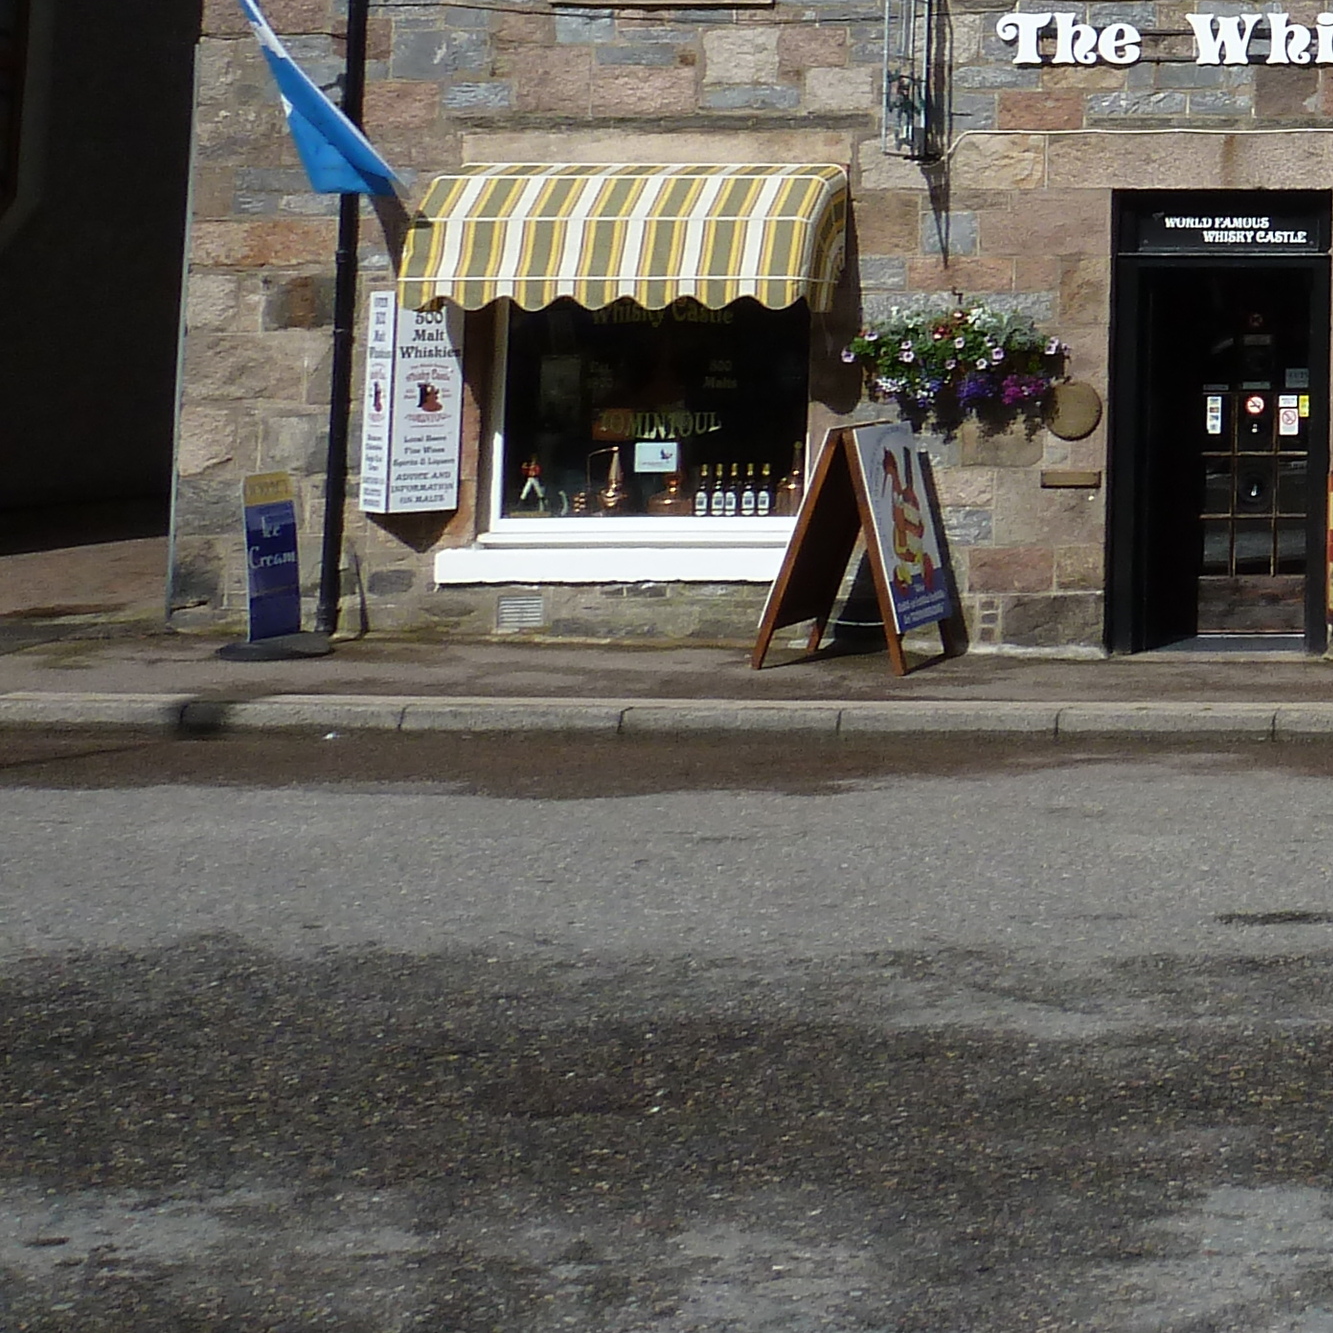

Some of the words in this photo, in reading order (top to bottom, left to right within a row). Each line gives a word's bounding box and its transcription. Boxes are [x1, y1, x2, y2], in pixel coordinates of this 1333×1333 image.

[997, 12, 1141, 64] The
[1164, 217, 1212, 229] WORLD
[1214, 217, 1270, 229] FAMOUS
[1203, 231, 1254, 244] WHISKY
[1255, 231, 1308, 243] CASTLE
[412, 329, 445, 342] Malt
[400, 346, 461, 359] Whiskies
[598, 410, 723, 440] TOMINTOUL
[249, 545, 296, 569] Cream
